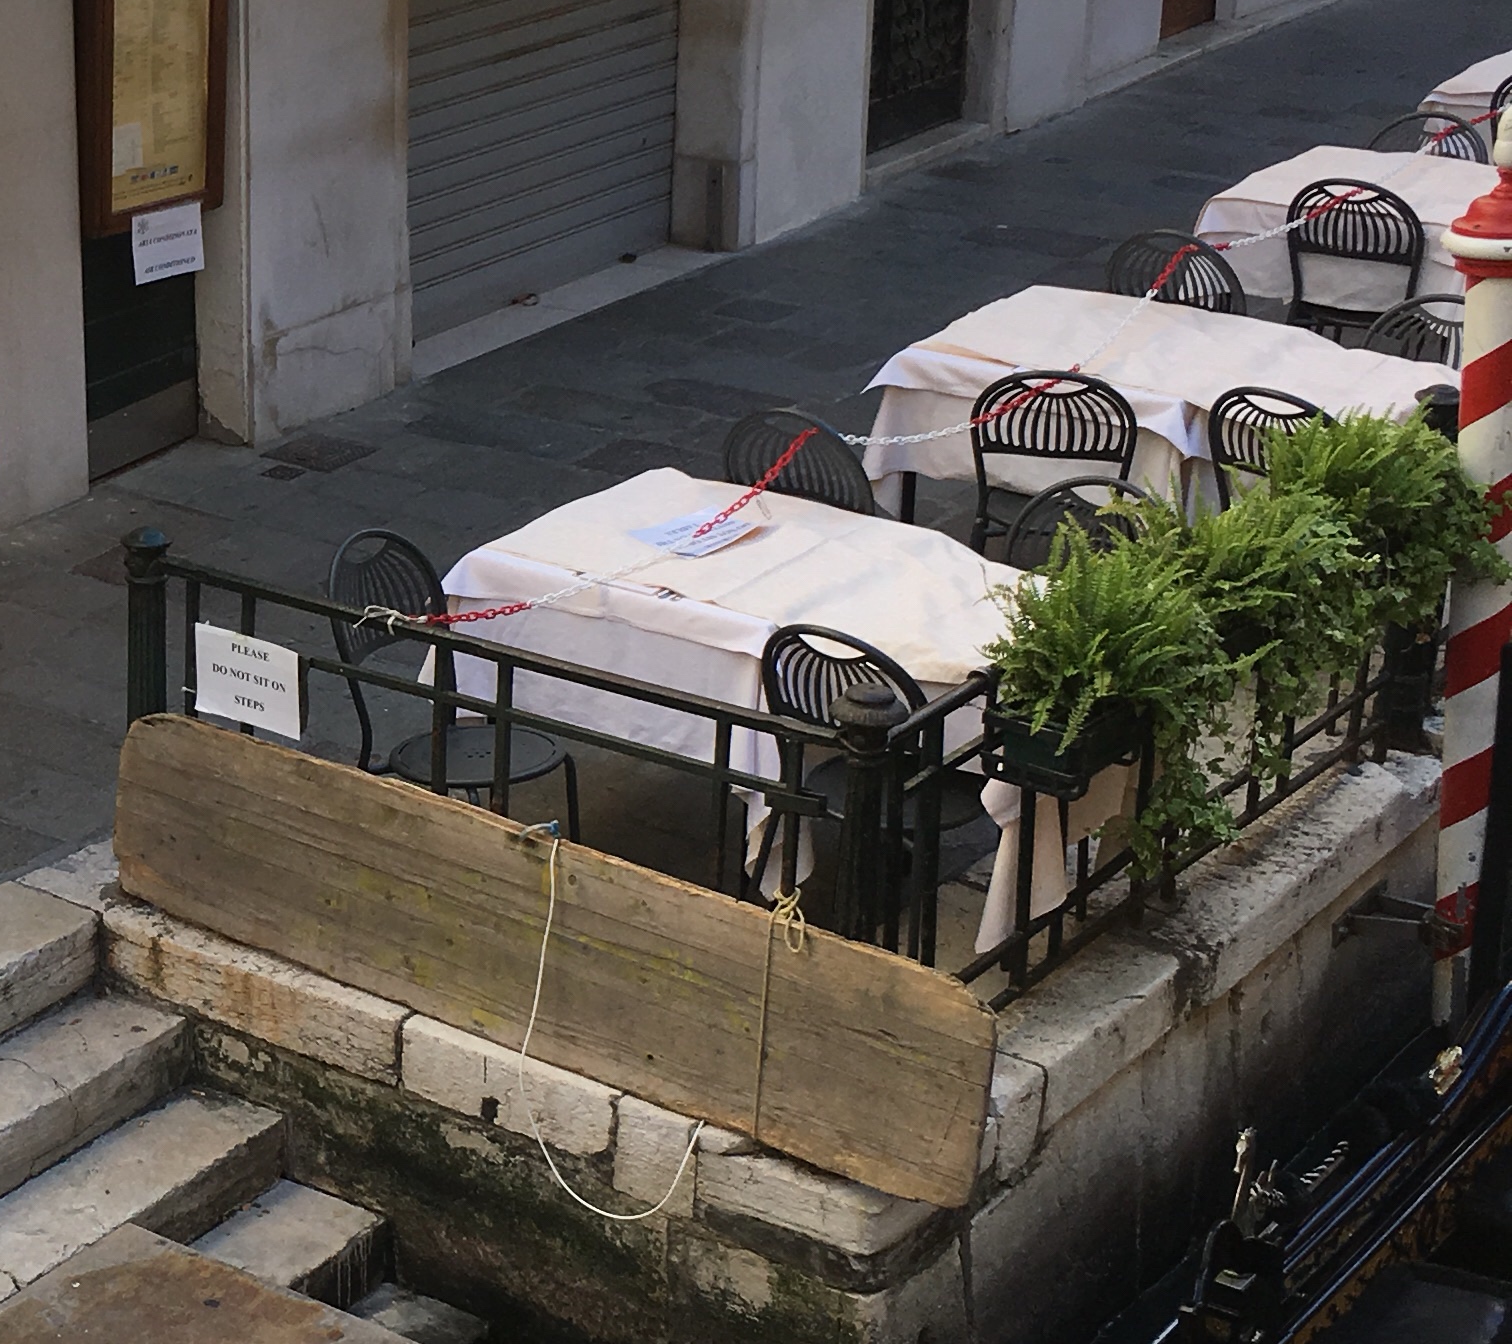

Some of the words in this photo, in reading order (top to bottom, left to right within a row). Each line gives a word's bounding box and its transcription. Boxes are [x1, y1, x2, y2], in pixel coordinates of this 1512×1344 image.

[231, 642, 270, 662] PLEASE
[212, 663, 228, 675] DO
[230, 668, 251, 682] NOT
[253, 675, 270, 688] SIT
[271, 680, 286, 693] ON
[235, 695, 265, 712] STEPS
